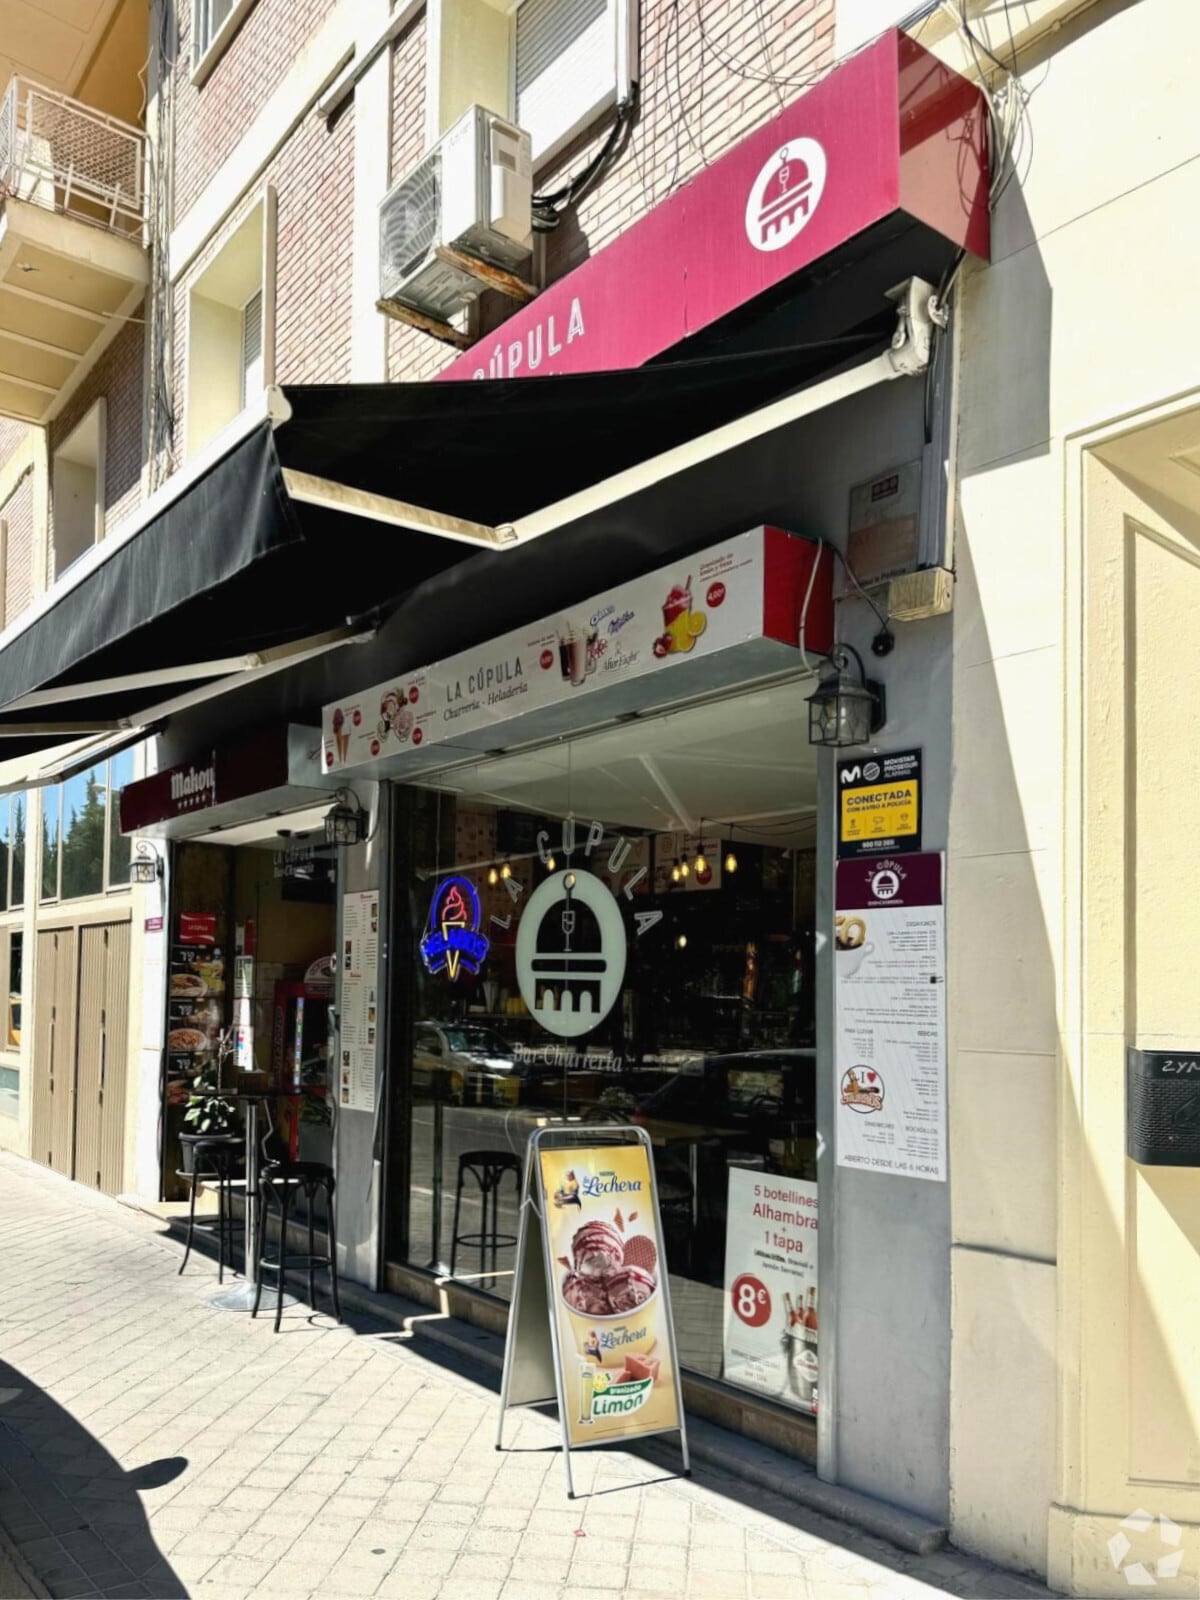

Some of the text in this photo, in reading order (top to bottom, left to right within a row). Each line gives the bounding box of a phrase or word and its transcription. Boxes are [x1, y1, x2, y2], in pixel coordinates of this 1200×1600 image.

[471, 296, 585, 380] ÚPULA
[446, 656, 523, 702] LA CÚPULA
[171, 766, 214, 800] Mahou
[847, 789, 911, 806] CONECTADA
[490, 812, 663, 936] LA CÚPULA
[865, 859, 907, 882] LA CÚPULA
[513, 1042, 622, 1073] Bar-Churrería
[871, 1158, 893, 1169] DESDE
[894, 1162, 907, 1170] LAS
[915, 1165, 939, 1175] HORAS
[583, 1176, 642, 1197] Lechera
[754, 1185, 820, 1208] 5 botellines
[753, 1203, 819, 1230] Alhambra
[764, 1231, 803, 1254] 1 tapa
[738, 1283, 768, 1318] 8€
[601, 1327, 647, 1349] Lechera
[593, 1393, 644, 1415] Limón
